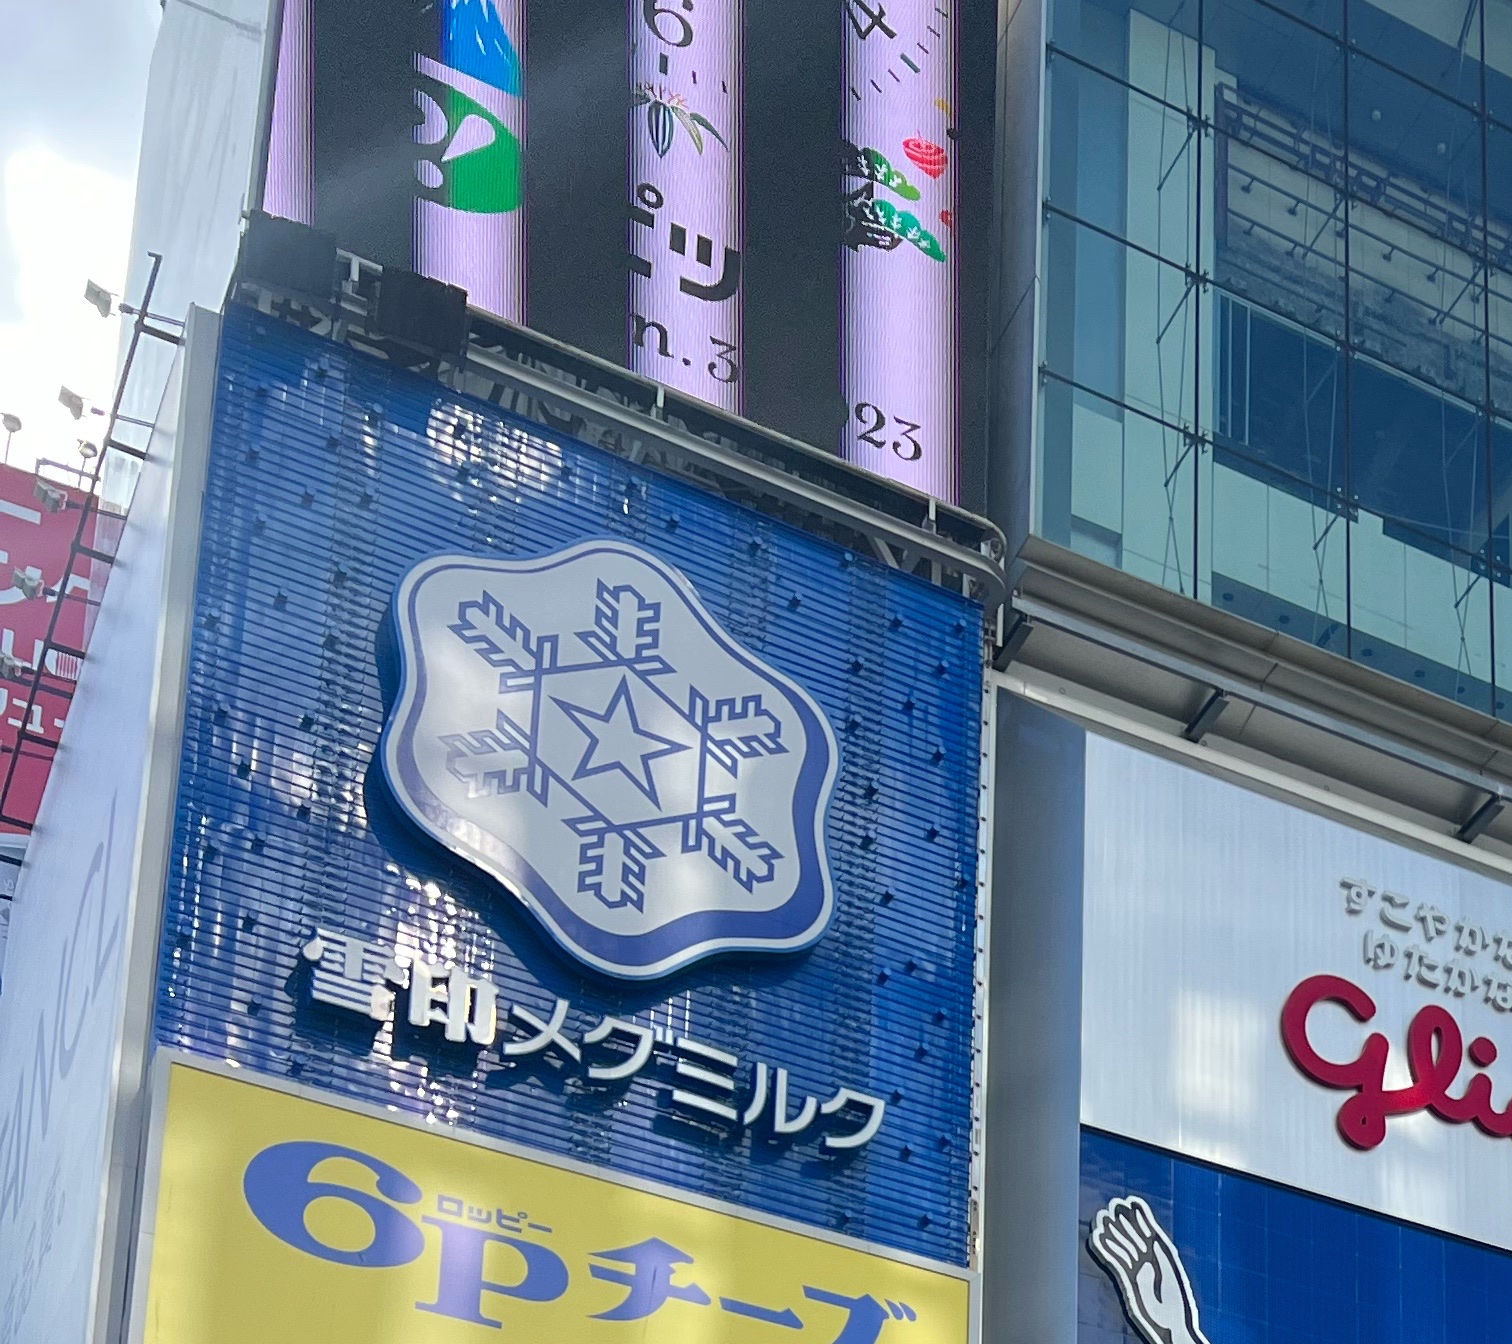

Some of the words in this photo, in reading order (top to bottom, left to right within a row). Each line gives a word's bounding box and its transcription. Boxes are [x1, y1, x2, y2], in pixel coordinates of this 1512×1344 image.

[0, 787, 120, 1222] ANCL
[437, 1194, 553, 1233] ロッピー
